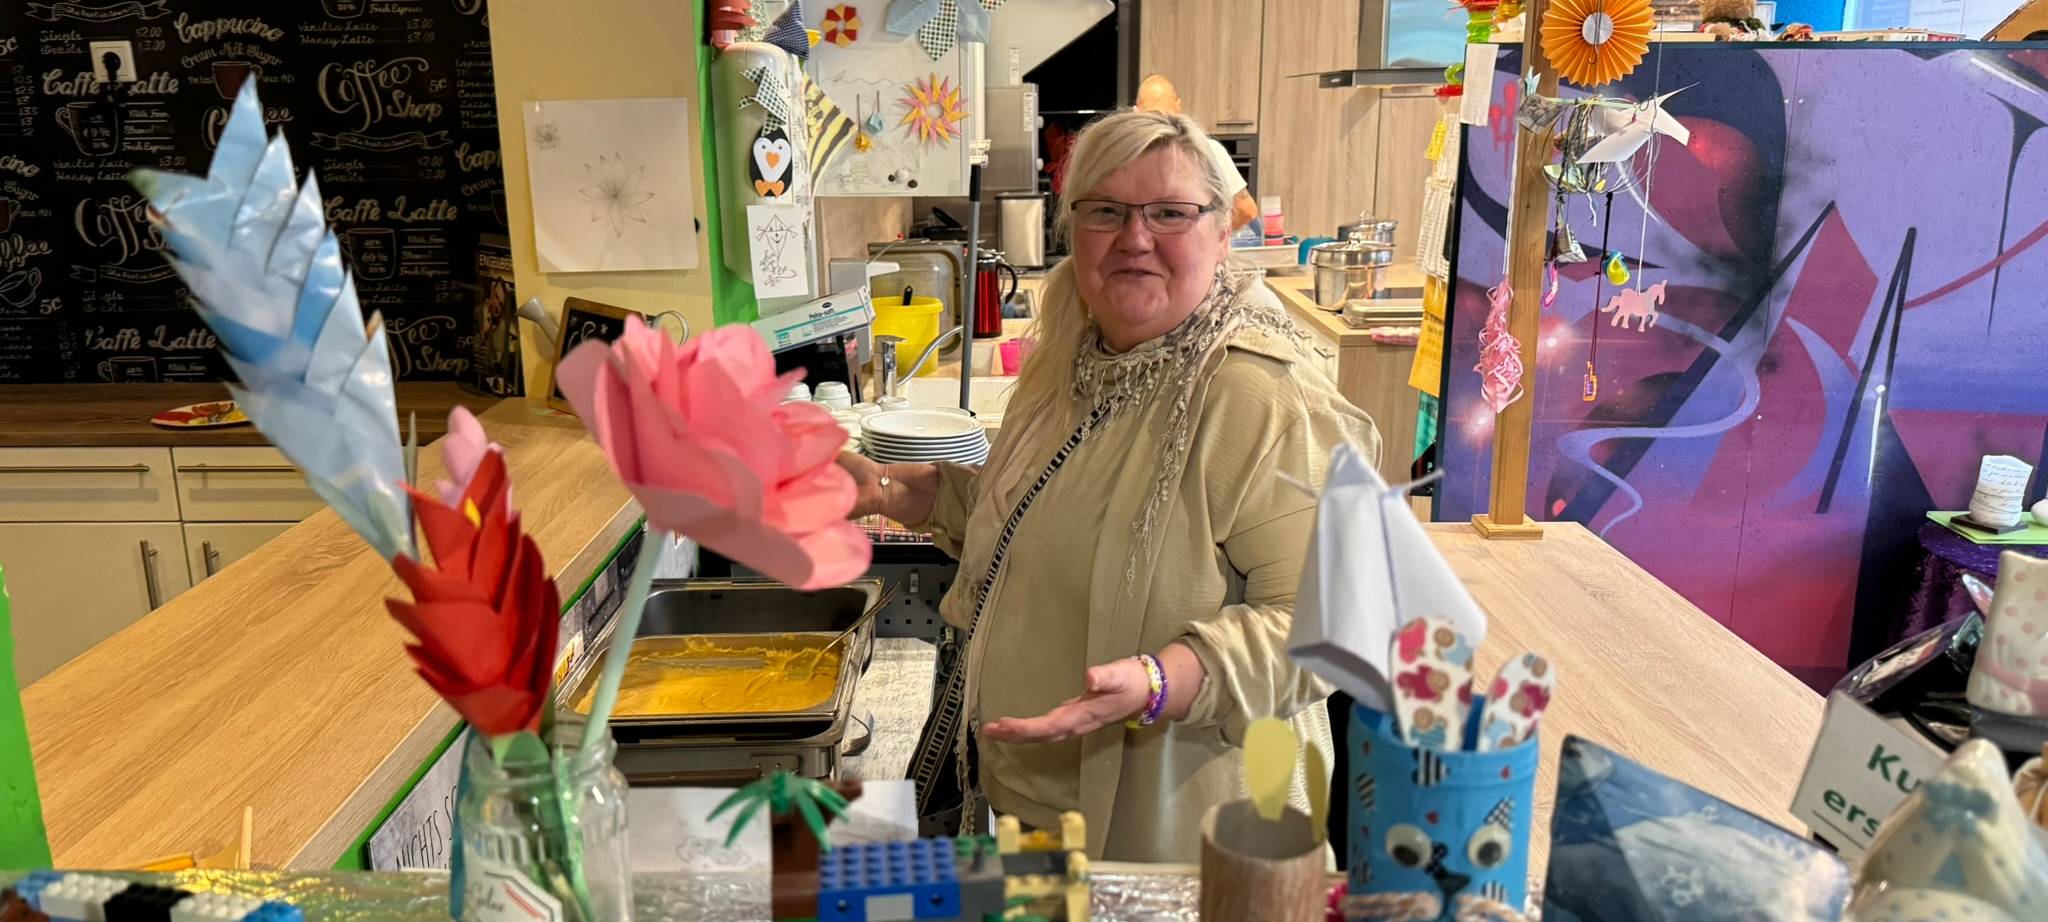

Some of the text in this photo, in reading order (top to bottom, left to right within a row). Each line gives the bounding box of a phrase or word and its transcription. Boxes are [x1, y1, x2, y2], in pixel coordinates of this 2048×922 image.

[127, 71, 180, 97] atte
[386, 89, 443, 123] Shop
[386, 195, 459, 223] Latte
[147, 324, 218, 351] Latte
